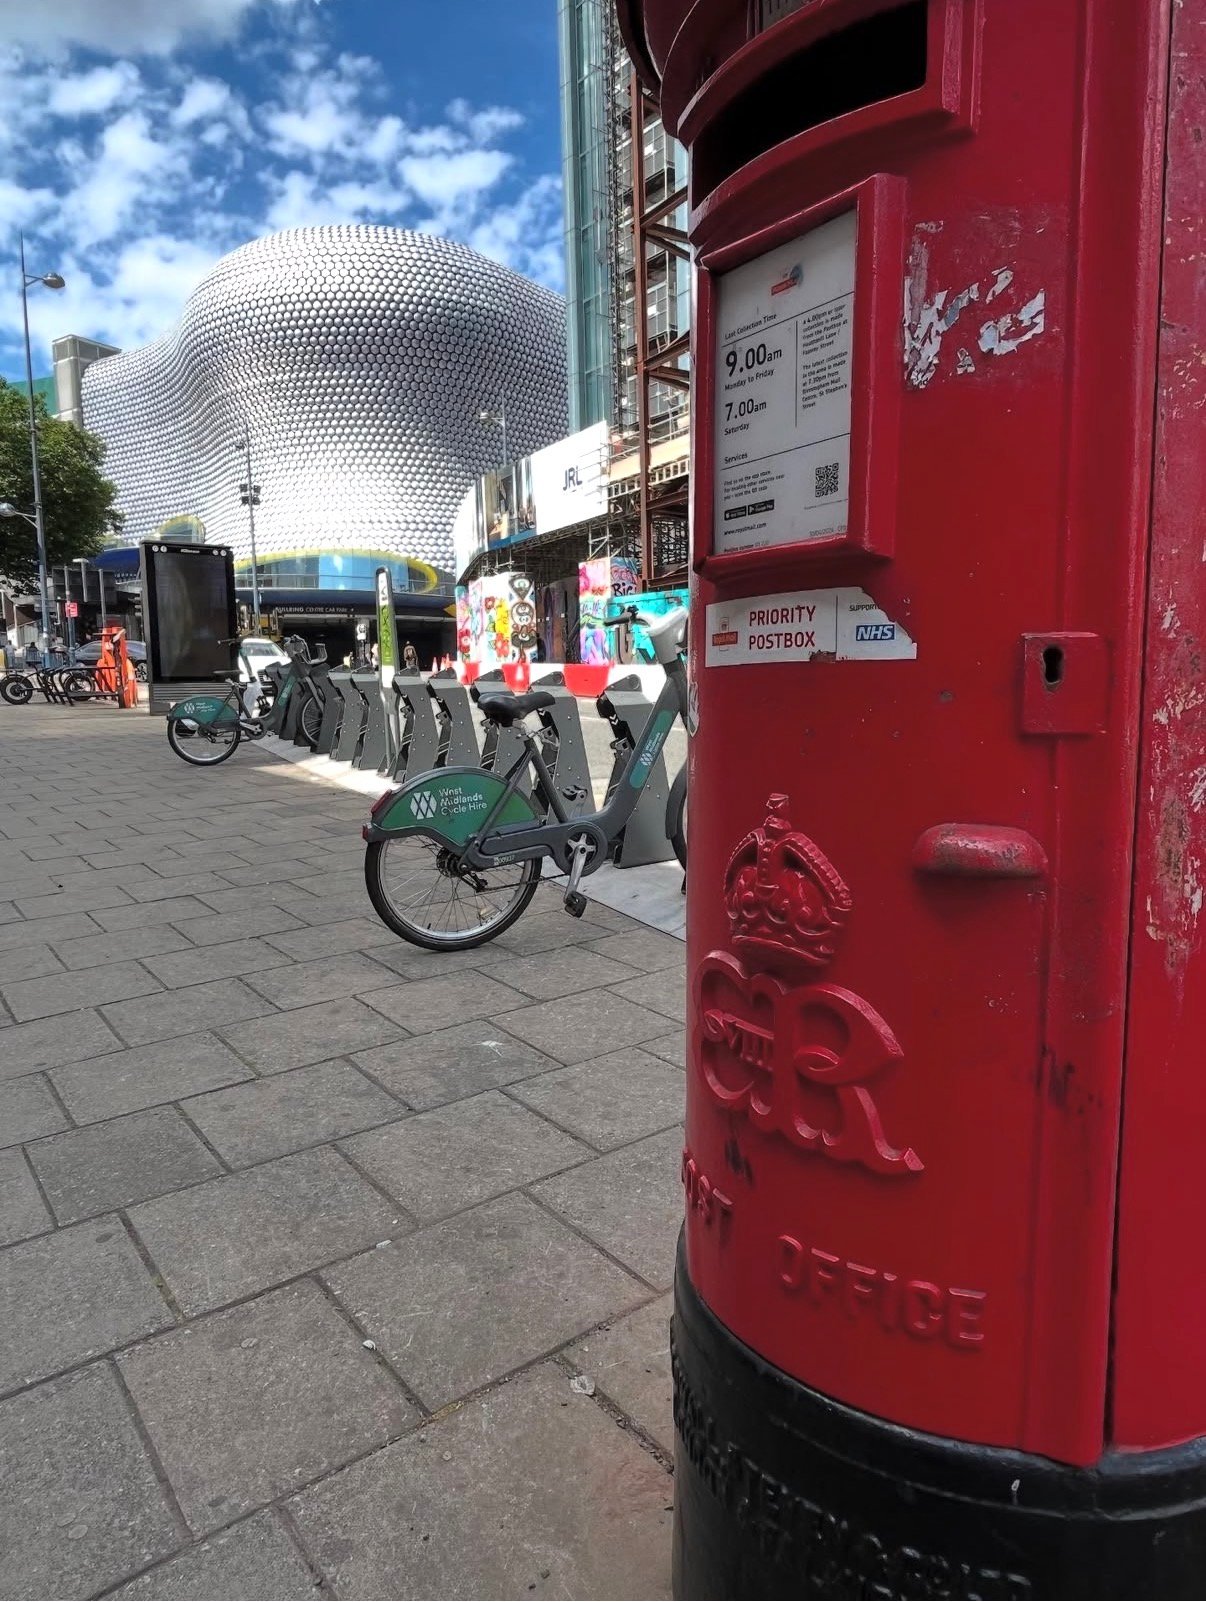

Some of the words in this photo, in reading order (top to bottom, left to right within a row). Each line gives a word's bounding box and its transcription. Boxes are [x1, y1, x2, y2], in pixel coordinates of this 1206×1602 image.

[724, 330, 736, 340] Last
[736, 318, 762, 335] Collection
[763, 313, 777, 326] Time
[830, 313, 844, 322] made
[820, 340, 834, 349] Street
[725, 343, 782, 378] 9.00am
[724, 379, 747, 392] Monday
[756, 368, 775, 380] Friday
[725, 398, 767, 422] 7.00am
[724, 422, 750, 436] Saturday
[724, 452, 748, 464] Services
[563, 466, 582, 492] JRL
[750, 604, 816, 626] PRIORITY
[749, 630, 815, 650] POSTBOX
[856, 626, 894, 640] NHS
[439, 786, 463, 797] West
[440, 792, 483, 807] Midlands
[440, 804, 466, 817] Cycle
[468, 801, 488, 813] Hire
[778, 1233, 987, 1347] OFFICE
